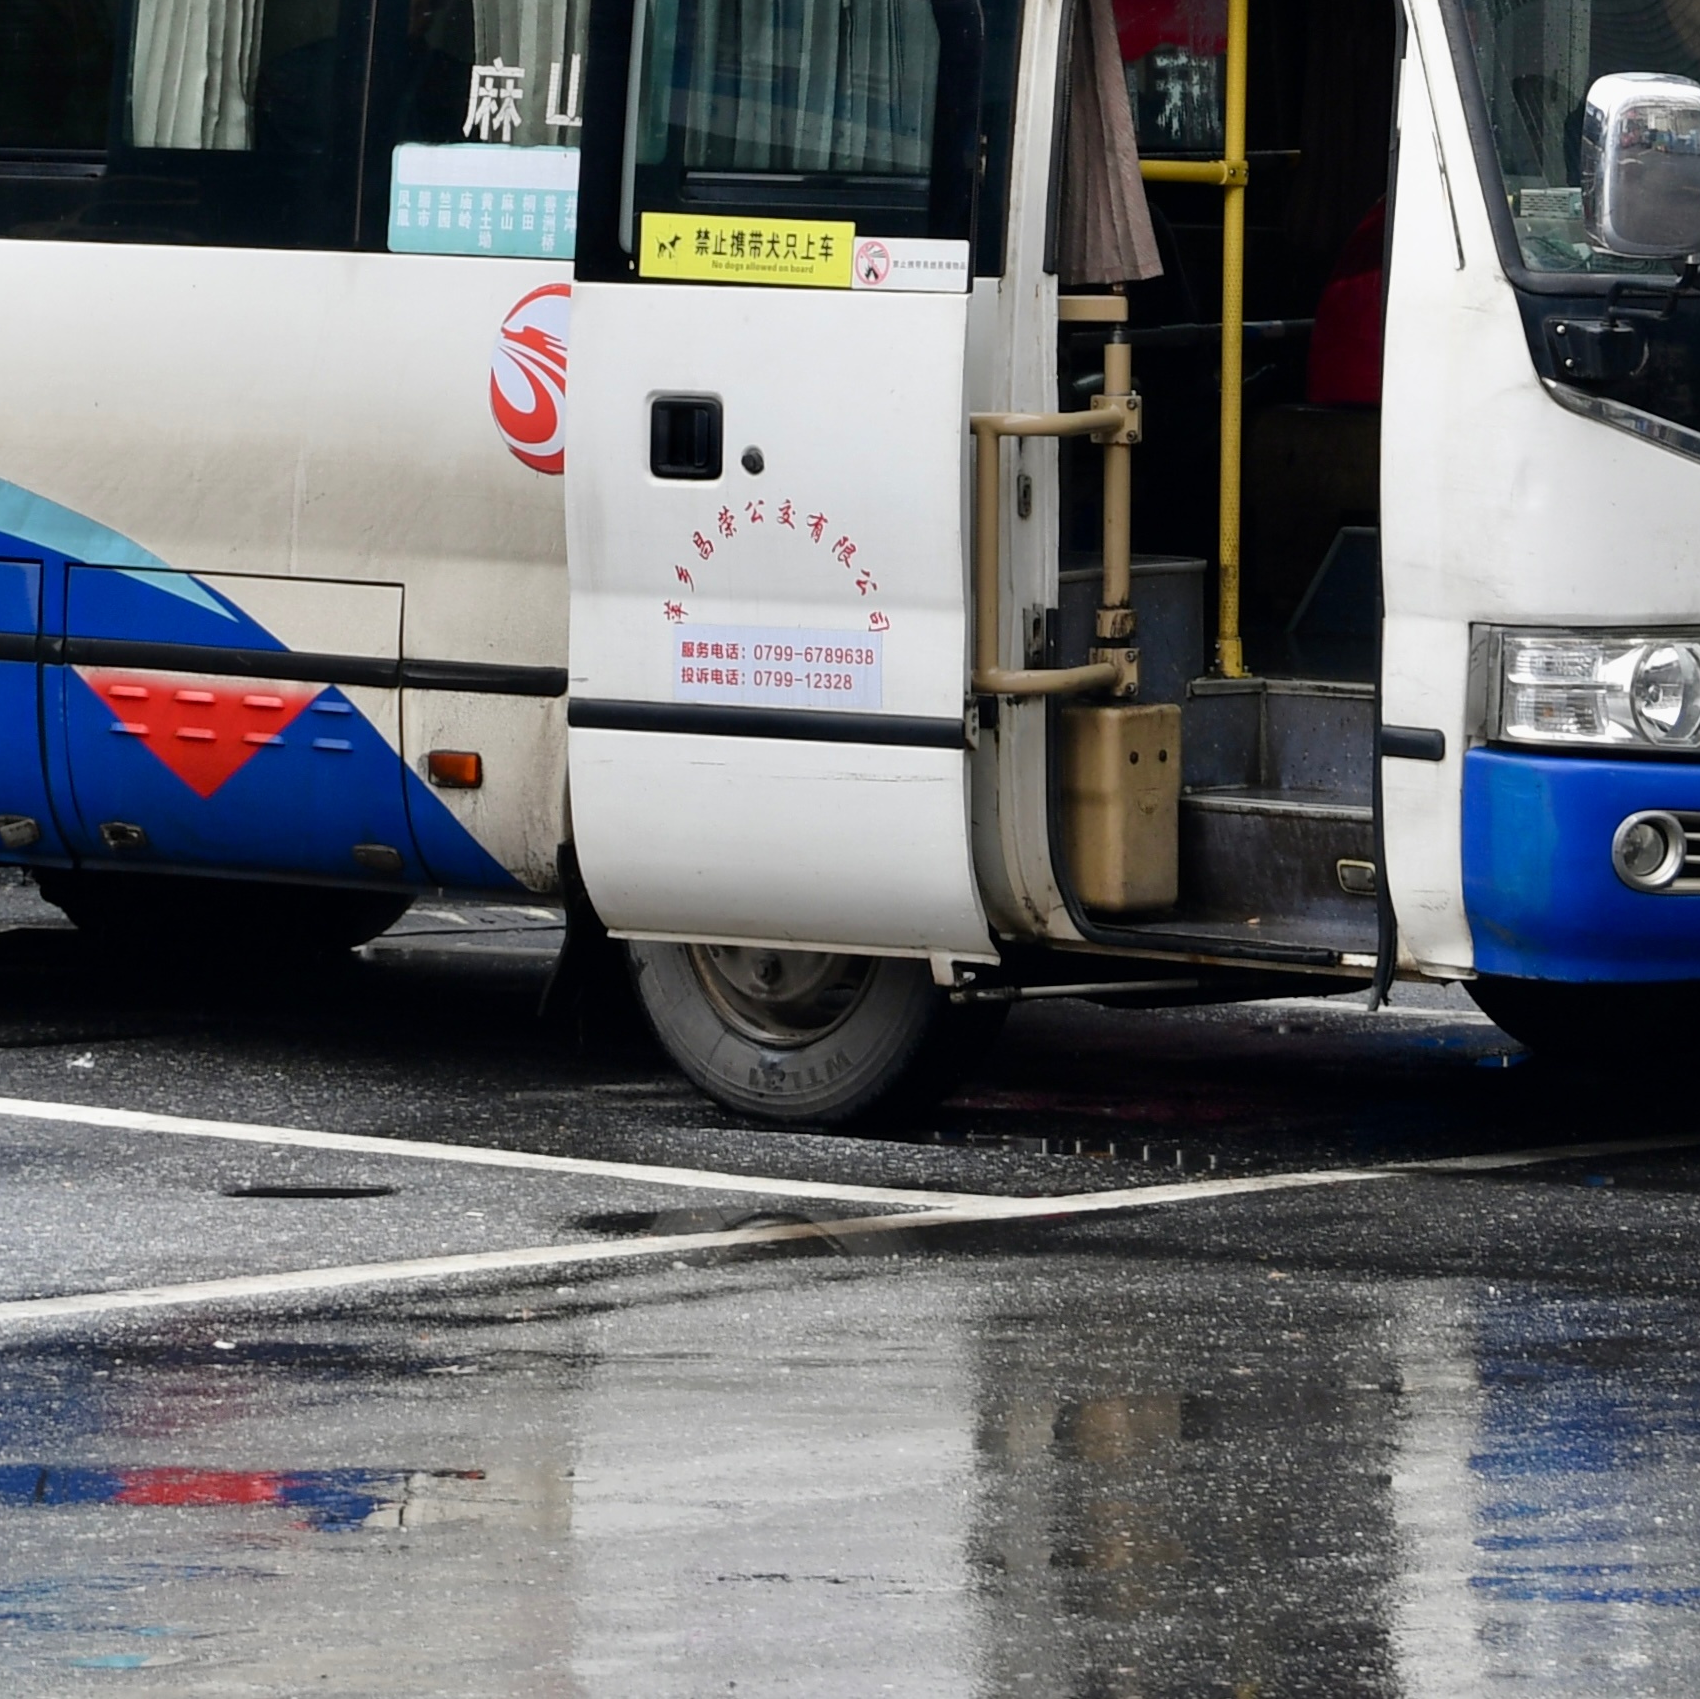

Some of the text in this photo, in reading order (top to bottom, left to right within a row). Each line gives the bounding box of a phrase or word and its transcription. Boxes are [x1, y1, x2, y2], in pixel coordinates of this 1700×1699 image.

[462, 53, 583, 142] 麻山
[694, 228, 835, 263] 禁止携带犬只上车
[711, 260, 815, 275] No dogs allowed on board
